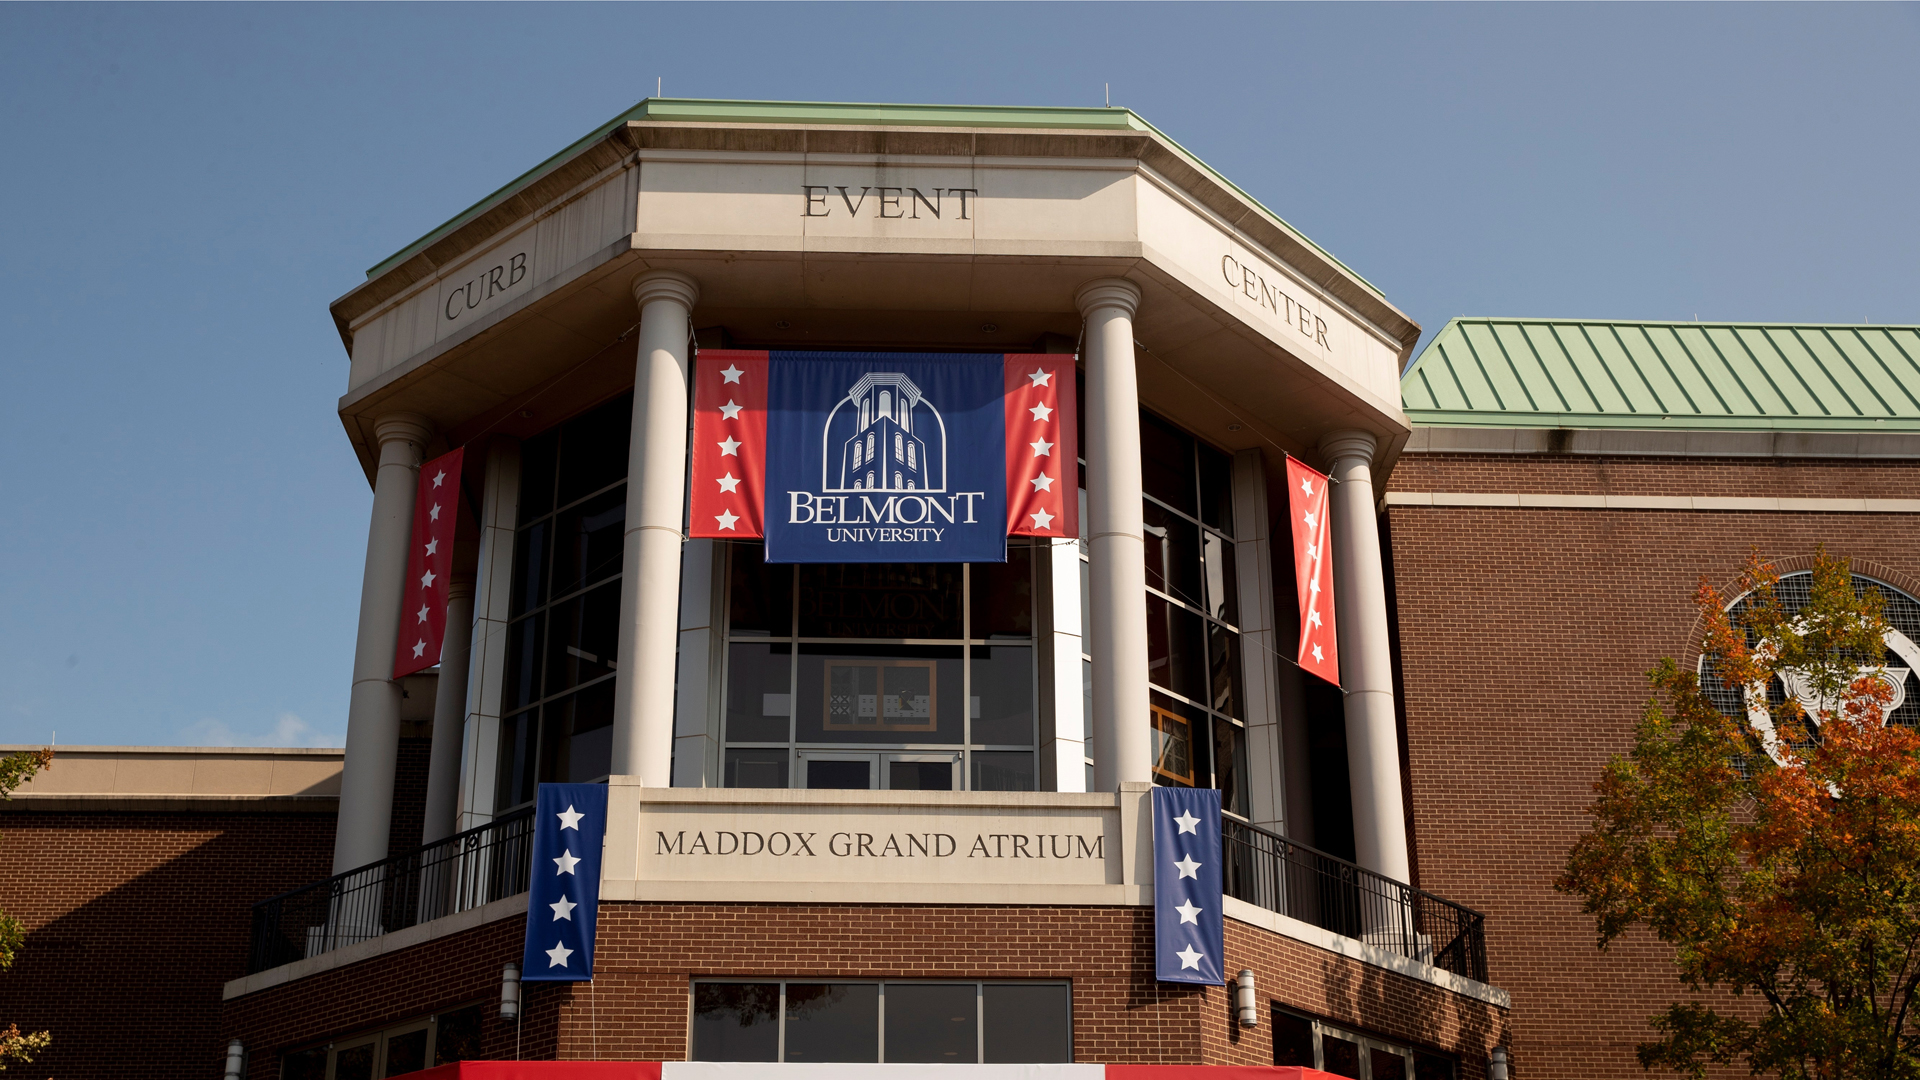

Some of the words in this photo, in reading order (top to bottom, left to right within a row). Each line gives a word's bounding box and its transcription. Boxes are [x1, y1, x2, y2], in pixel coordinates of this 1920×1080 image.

[800, 185, 978, 220] EVENT
[445, 252, 526, 321] CURB
[1221, 254, 1332, 353] CENTER
[787, 491, 984, 524] BELMONT
[826, 528, 945, 542] UNIVERSITY
[654, 831, 817, 857] MADDOX
[828, 832, 957, 858] GRAND
[966, 834, 1106, 860] ATRIUM
